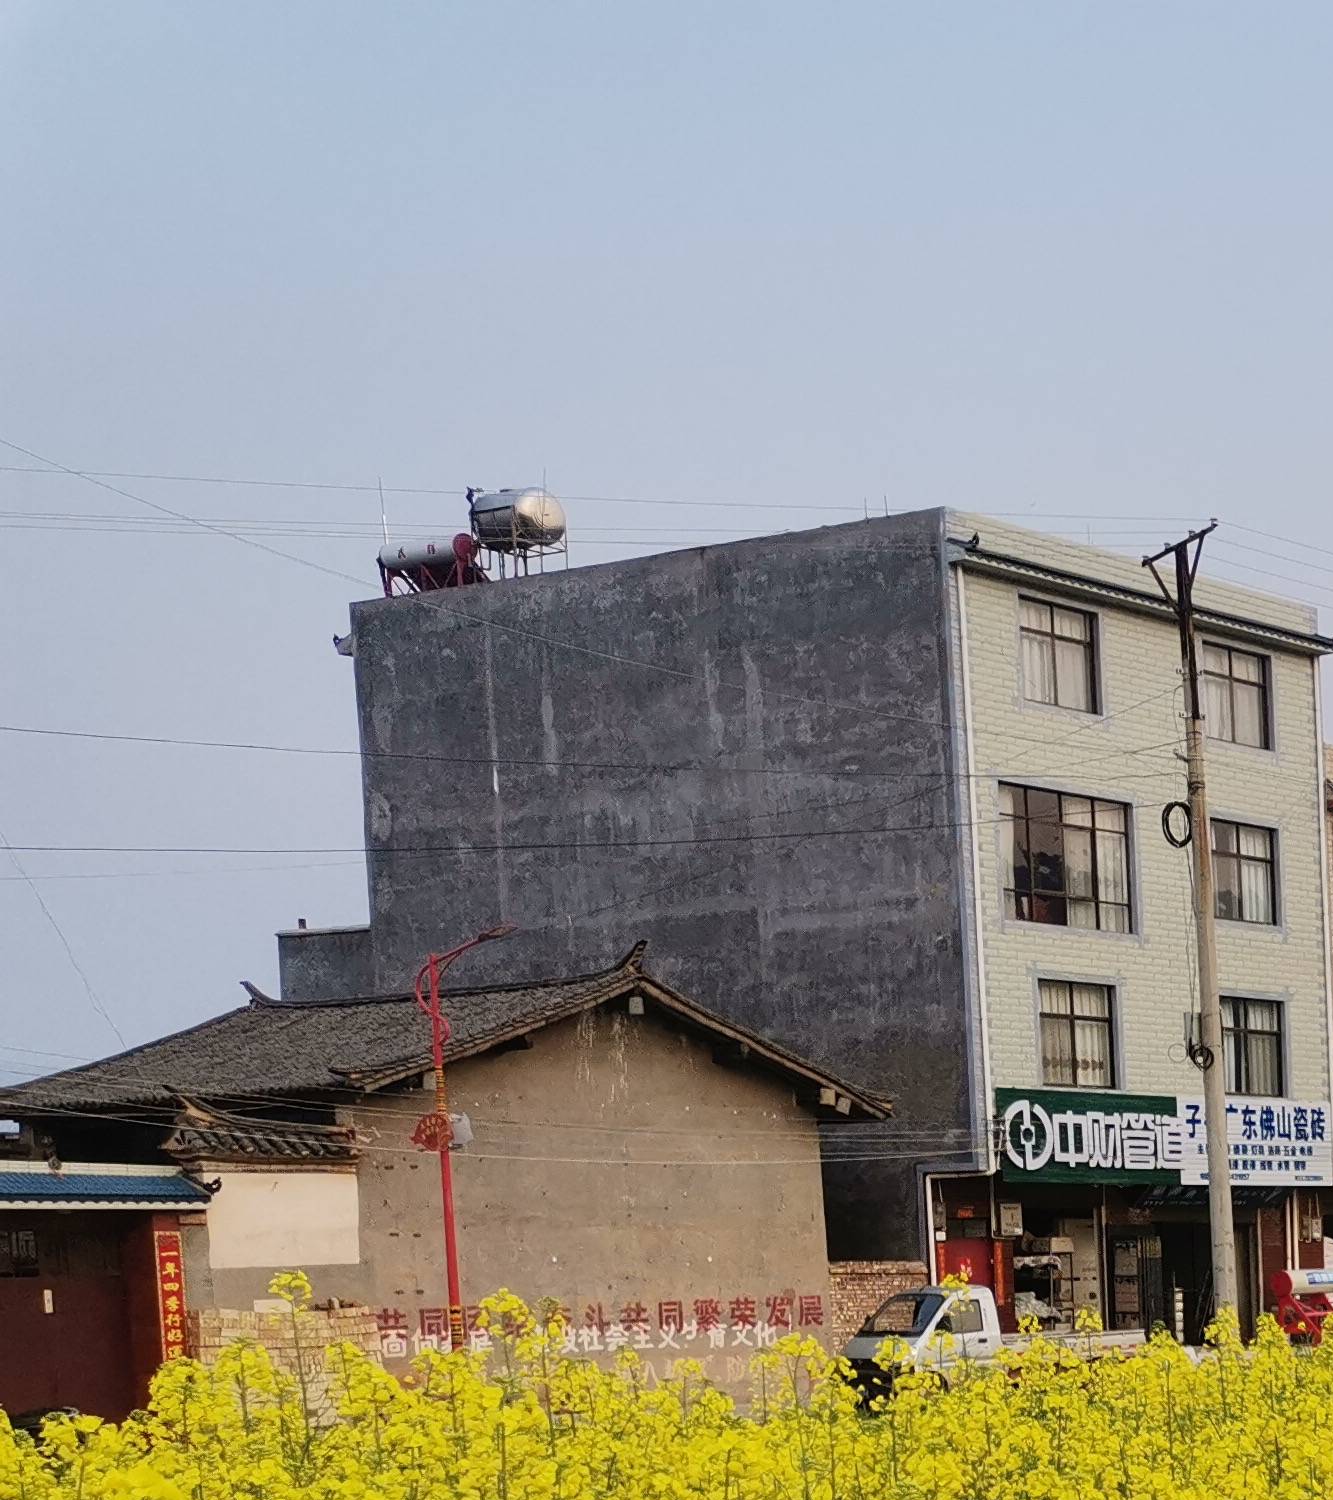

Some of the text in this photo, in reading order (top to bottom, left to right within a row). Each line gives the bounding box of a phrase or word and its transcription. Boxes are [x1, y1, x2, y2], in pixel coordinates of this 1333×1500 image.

[1052, 1110, 1187, 1170] 中财管道
[1185, 1103, 1326, 1142] 子广东佛山瓷砖
[374, 1294, 825, 1342] 共同斗共同繁荣发展
